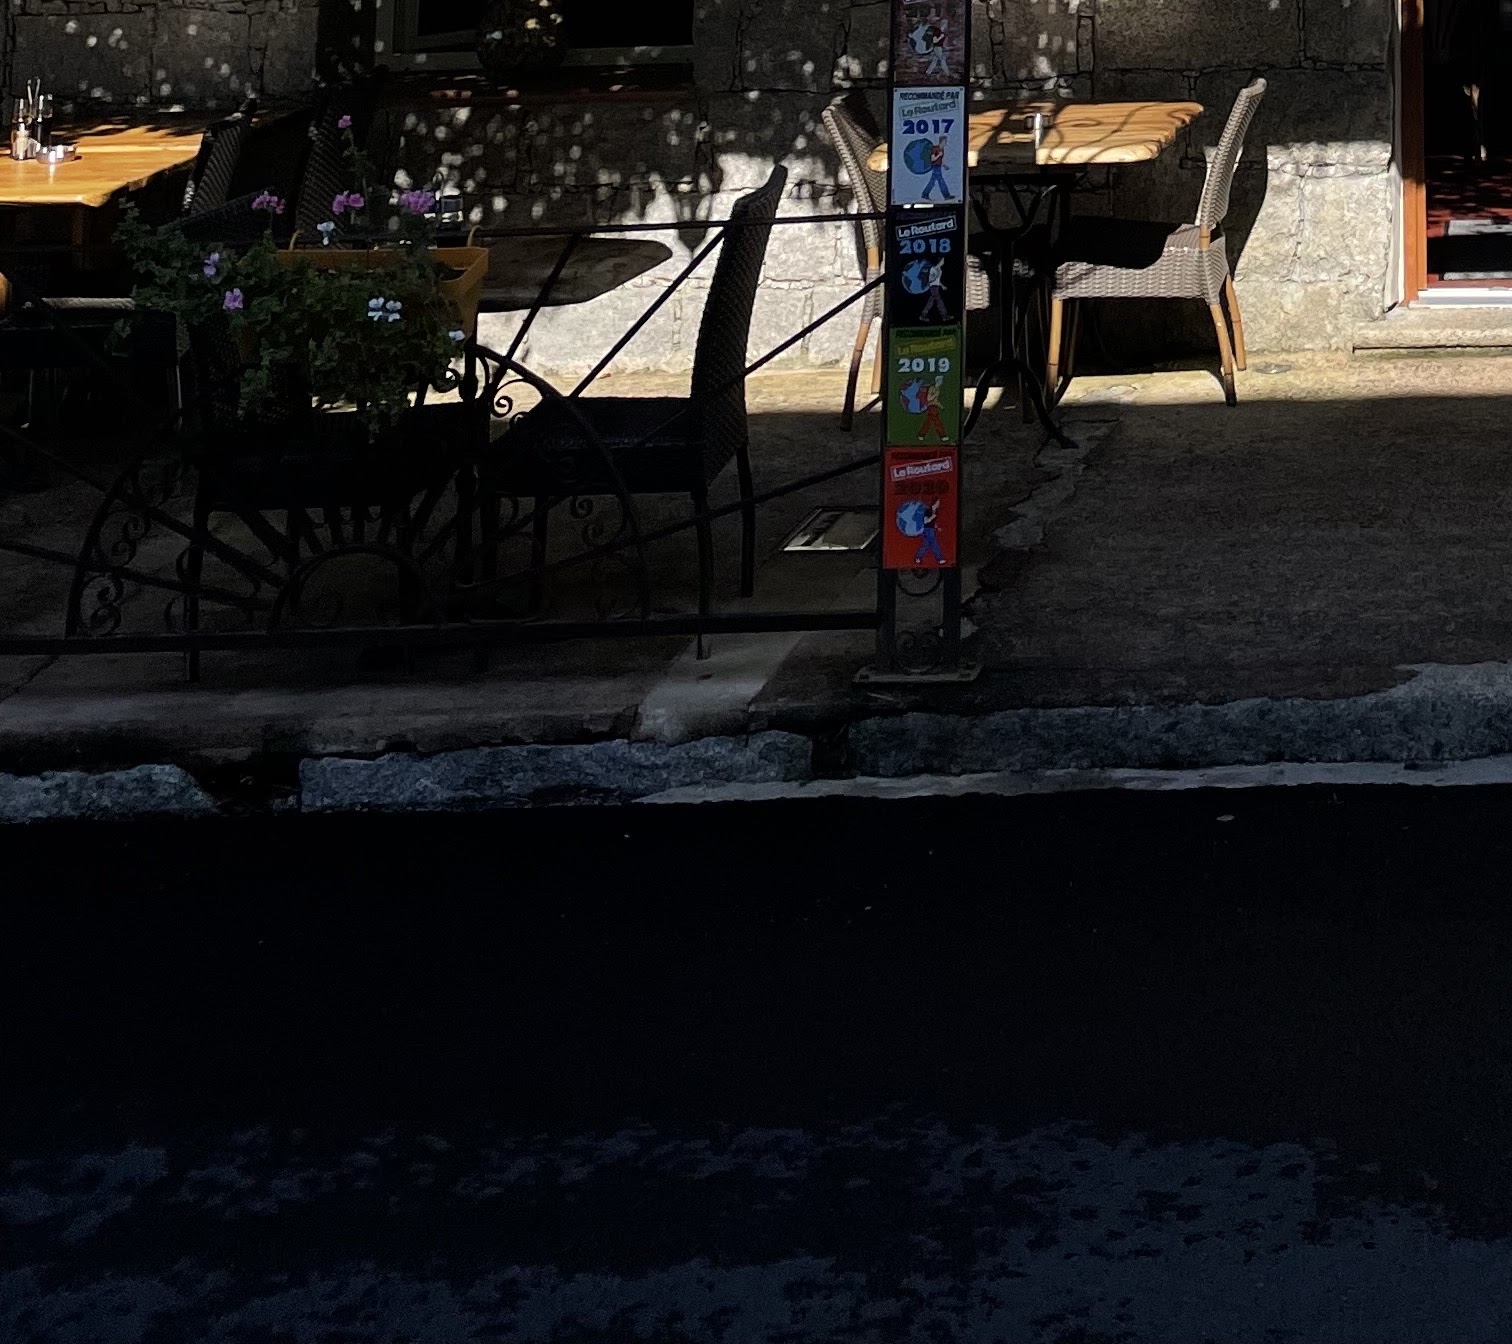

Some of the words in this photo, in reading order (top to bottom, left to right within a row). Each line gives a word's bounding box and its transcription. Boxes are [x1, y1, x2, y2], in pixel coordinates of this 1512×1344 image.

[901, 108, 914, 117] Le
[914, 100, 957, 115] Routard
[902, 119, 955, 135] 2017
[898, 228, 911, 238] Le
[910, 218, 954, 236] Routard
[899, 238, 952, 255] 2018
[897, 346, 910, 356] Le
[910, 337, 953, 353] Routard
[897, 357, 951, 373] 2019
[893, 467, 906, 478] Le
[906, 459, 950, 475] Routard
